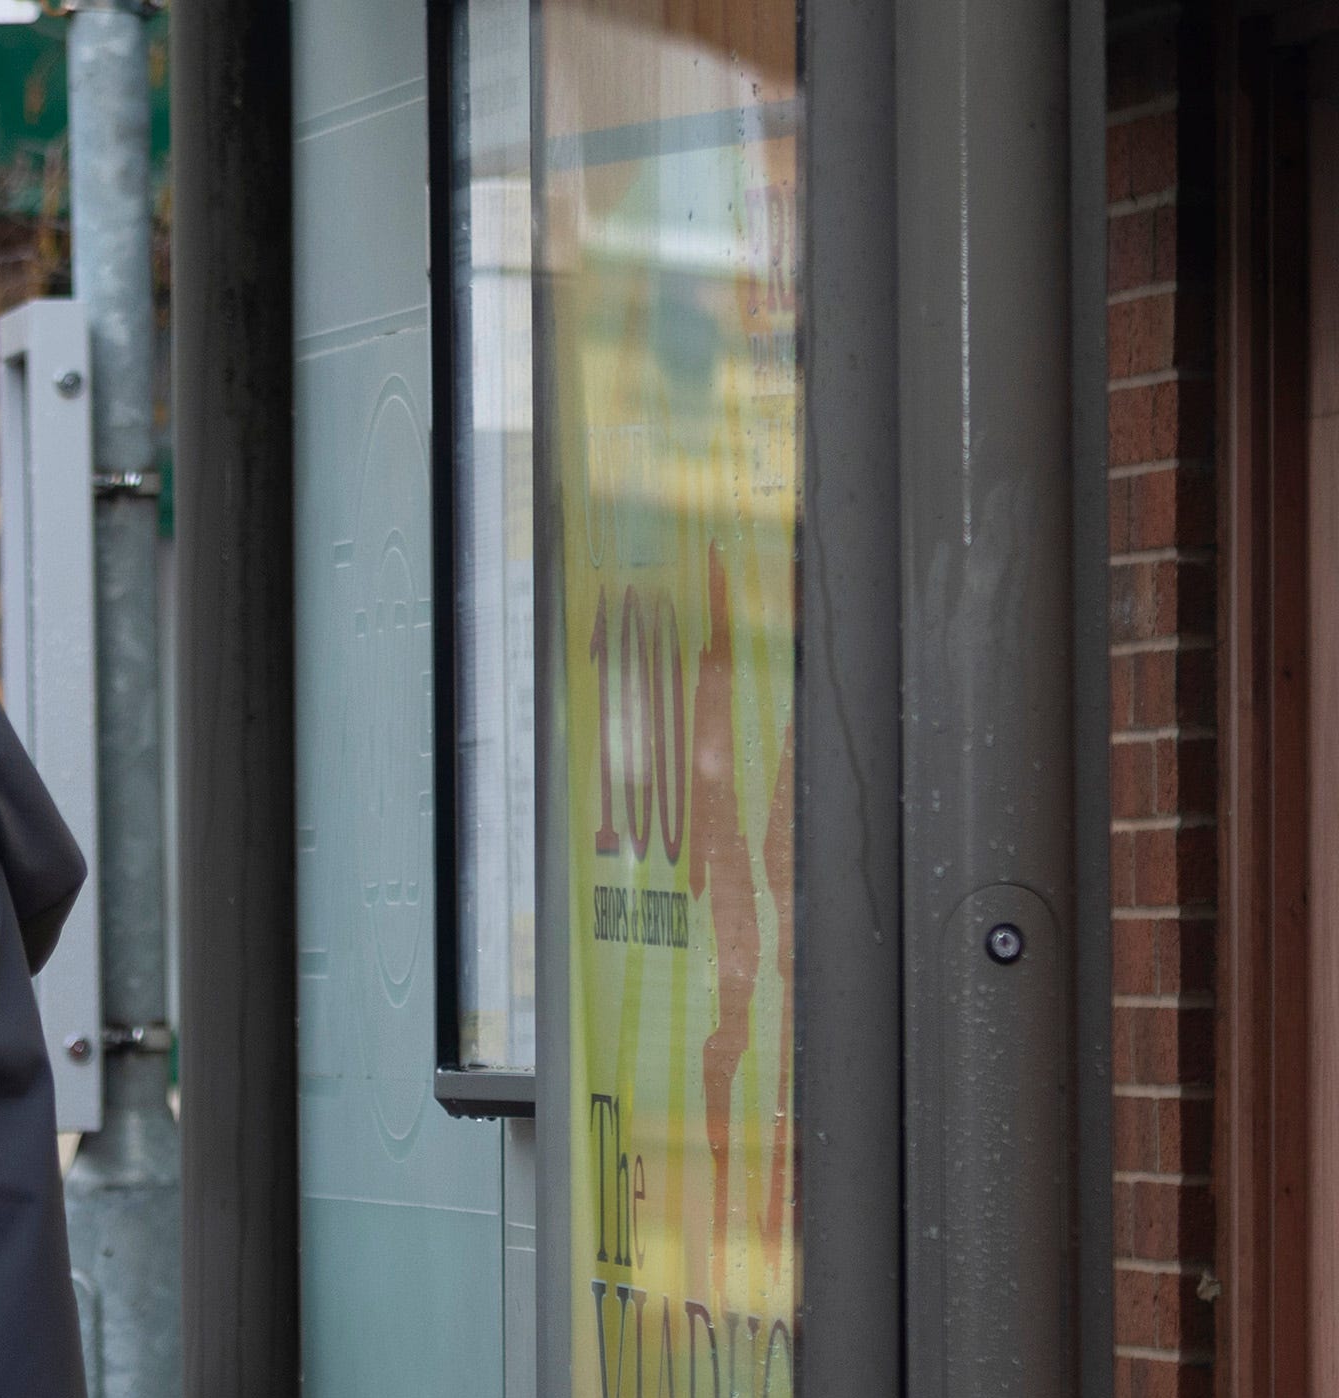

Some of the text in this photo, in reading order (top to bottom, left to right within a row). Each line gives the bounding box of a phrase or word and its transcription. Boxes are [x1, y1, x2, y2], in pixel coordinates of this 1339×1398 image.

[589, 582, 686, 866] 100
[594, 884, 690, 950] SHOPS & SERVICES
[590, 1093, 646, 1271] The
